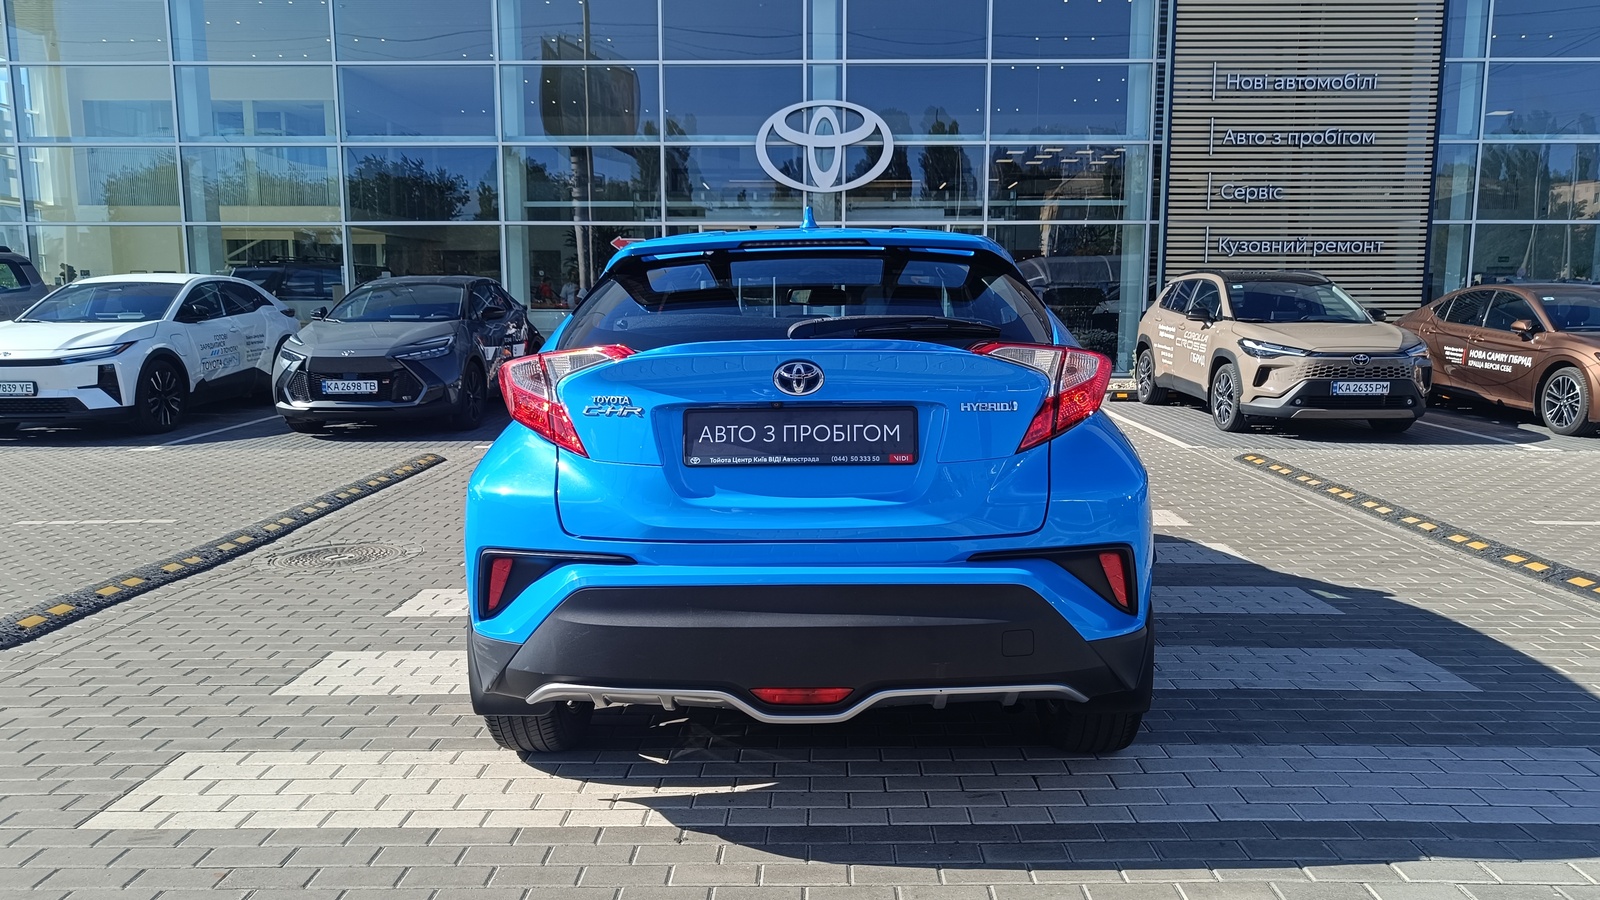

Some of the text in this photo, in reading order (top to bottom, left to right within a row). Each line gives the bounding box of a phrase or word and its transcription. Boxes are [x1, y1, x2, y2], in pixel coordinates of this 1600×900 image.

[1226, 72, 1378, 90] Нові автомобілі
[1222, 127, 1376, 149] Авто з пробігом
[1220, 184, 1284, 204] Сервіс
[1217, 236, 1385, 258] Кузовний ремонт
[1183, 330, 1209, 343] COROLLA
[1175, 337, 1207, 353] CROSS
[201, 359, 223, 371] TOYOTA
[1469, 349, 1486, 360] НОВА
[1486, 352, 1509, 363] CAMRY
[1508, 354, 1533, 368] ГІБРИД
[1467, 360, 1512, 373] КРАЩА ВЕРСІЯ СЕБЕ
[19, 383, 32, 393] YE
[326, 382, 377, 391] KA 2698 TB
[1338, 383, 1389, 393] KA 2635 PM
[591, 395, 630, 405] TOYOTA
[582, 405, 643, 418] C-HR
[960, 402, 1010, 412] HYBRID
[698, 424, 900, 443] АВТО З ПРОБІГОМ
[710, 456, 731, 464] Тойота
[732, 456, 753, 464] Центр
[753, 455, 767, 463] Київ
[782, 455, 819, 463] Автострада
[831, 455, 848, 463] (044)
